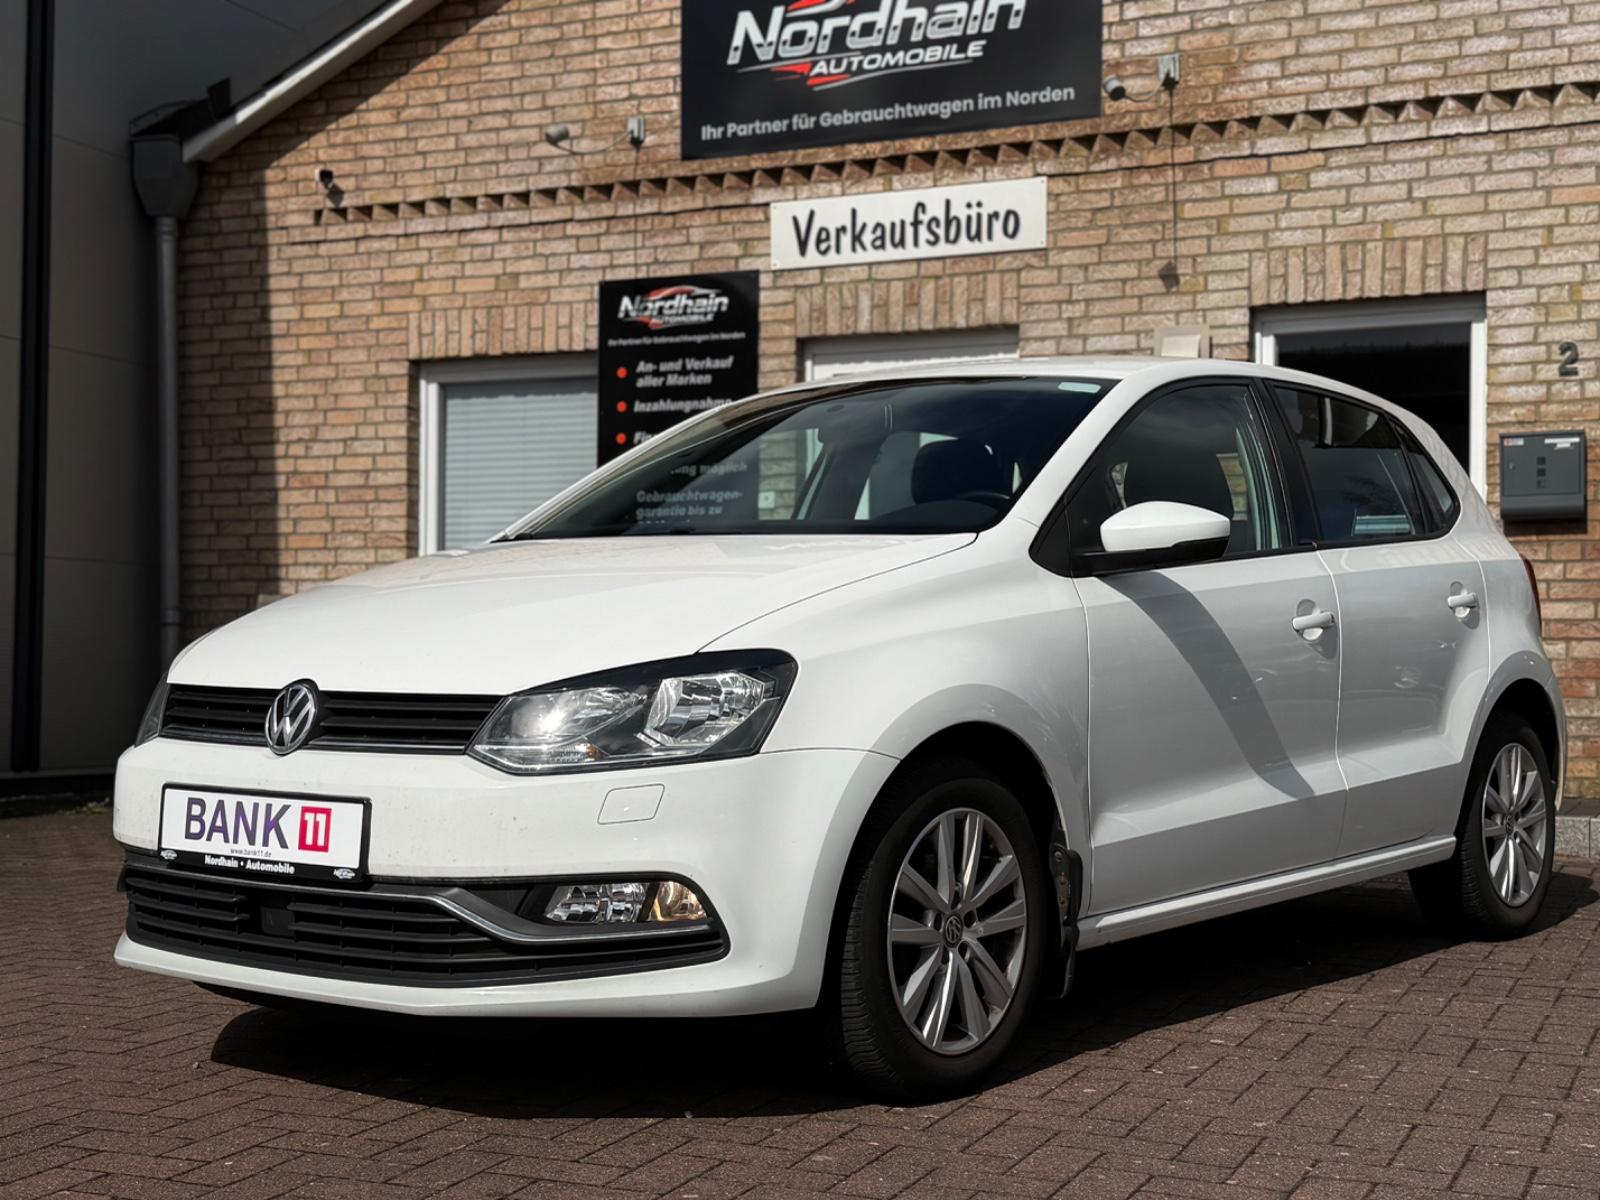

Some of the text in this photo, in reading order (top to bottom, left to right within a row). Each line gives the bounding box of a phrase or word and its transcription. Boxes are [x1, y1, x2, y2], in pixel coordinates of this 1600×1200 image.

[727, 0, 1027, 66] Nordhain
[809, 39, 987, 77] AUTOMOBILE
[701, 85, 1075, 142] Ihr Partner für Gebrauchtwagen im Norden
[792, 198, 1021, 257] Verkaufsbüro
[617, 293, 729, 319] Nordhain
[636, 355, 734, 373] An- und Verkauf
[1558, 341, 1579, 377] 2
[636, 372, 712, 388] aller Marken
[688, 504, 706, 516] bis
[708, 506, 723, 515] zu
[184, 797, 327, 849] BANK 11
[204, 855, 295, 874] Nordhain Automobile
